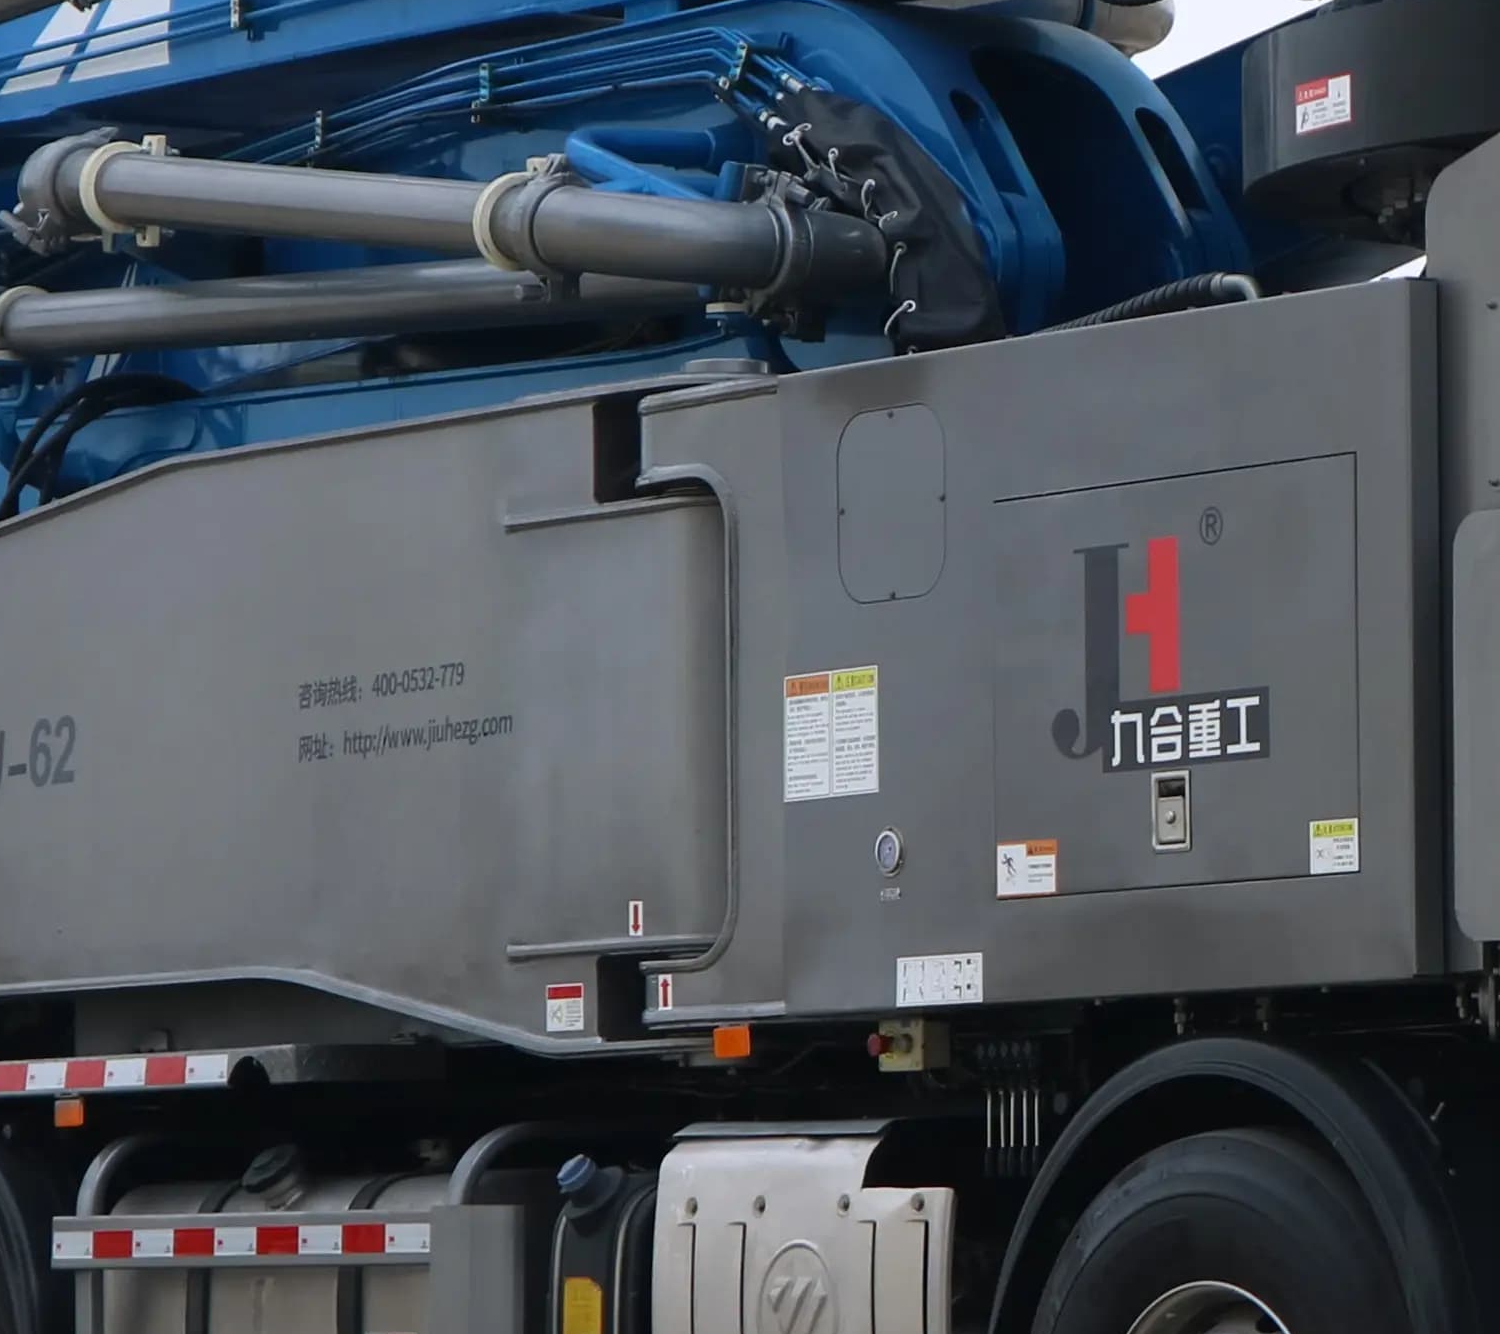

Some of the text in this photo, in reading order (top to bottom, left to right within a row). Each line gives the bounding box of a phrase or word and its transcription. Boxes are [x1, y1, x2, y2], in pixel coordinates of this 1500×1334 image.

[343, 714, 513, 759] http://www.jiuhezg.com
[1110, 695, 1261, 767] 九合重工
